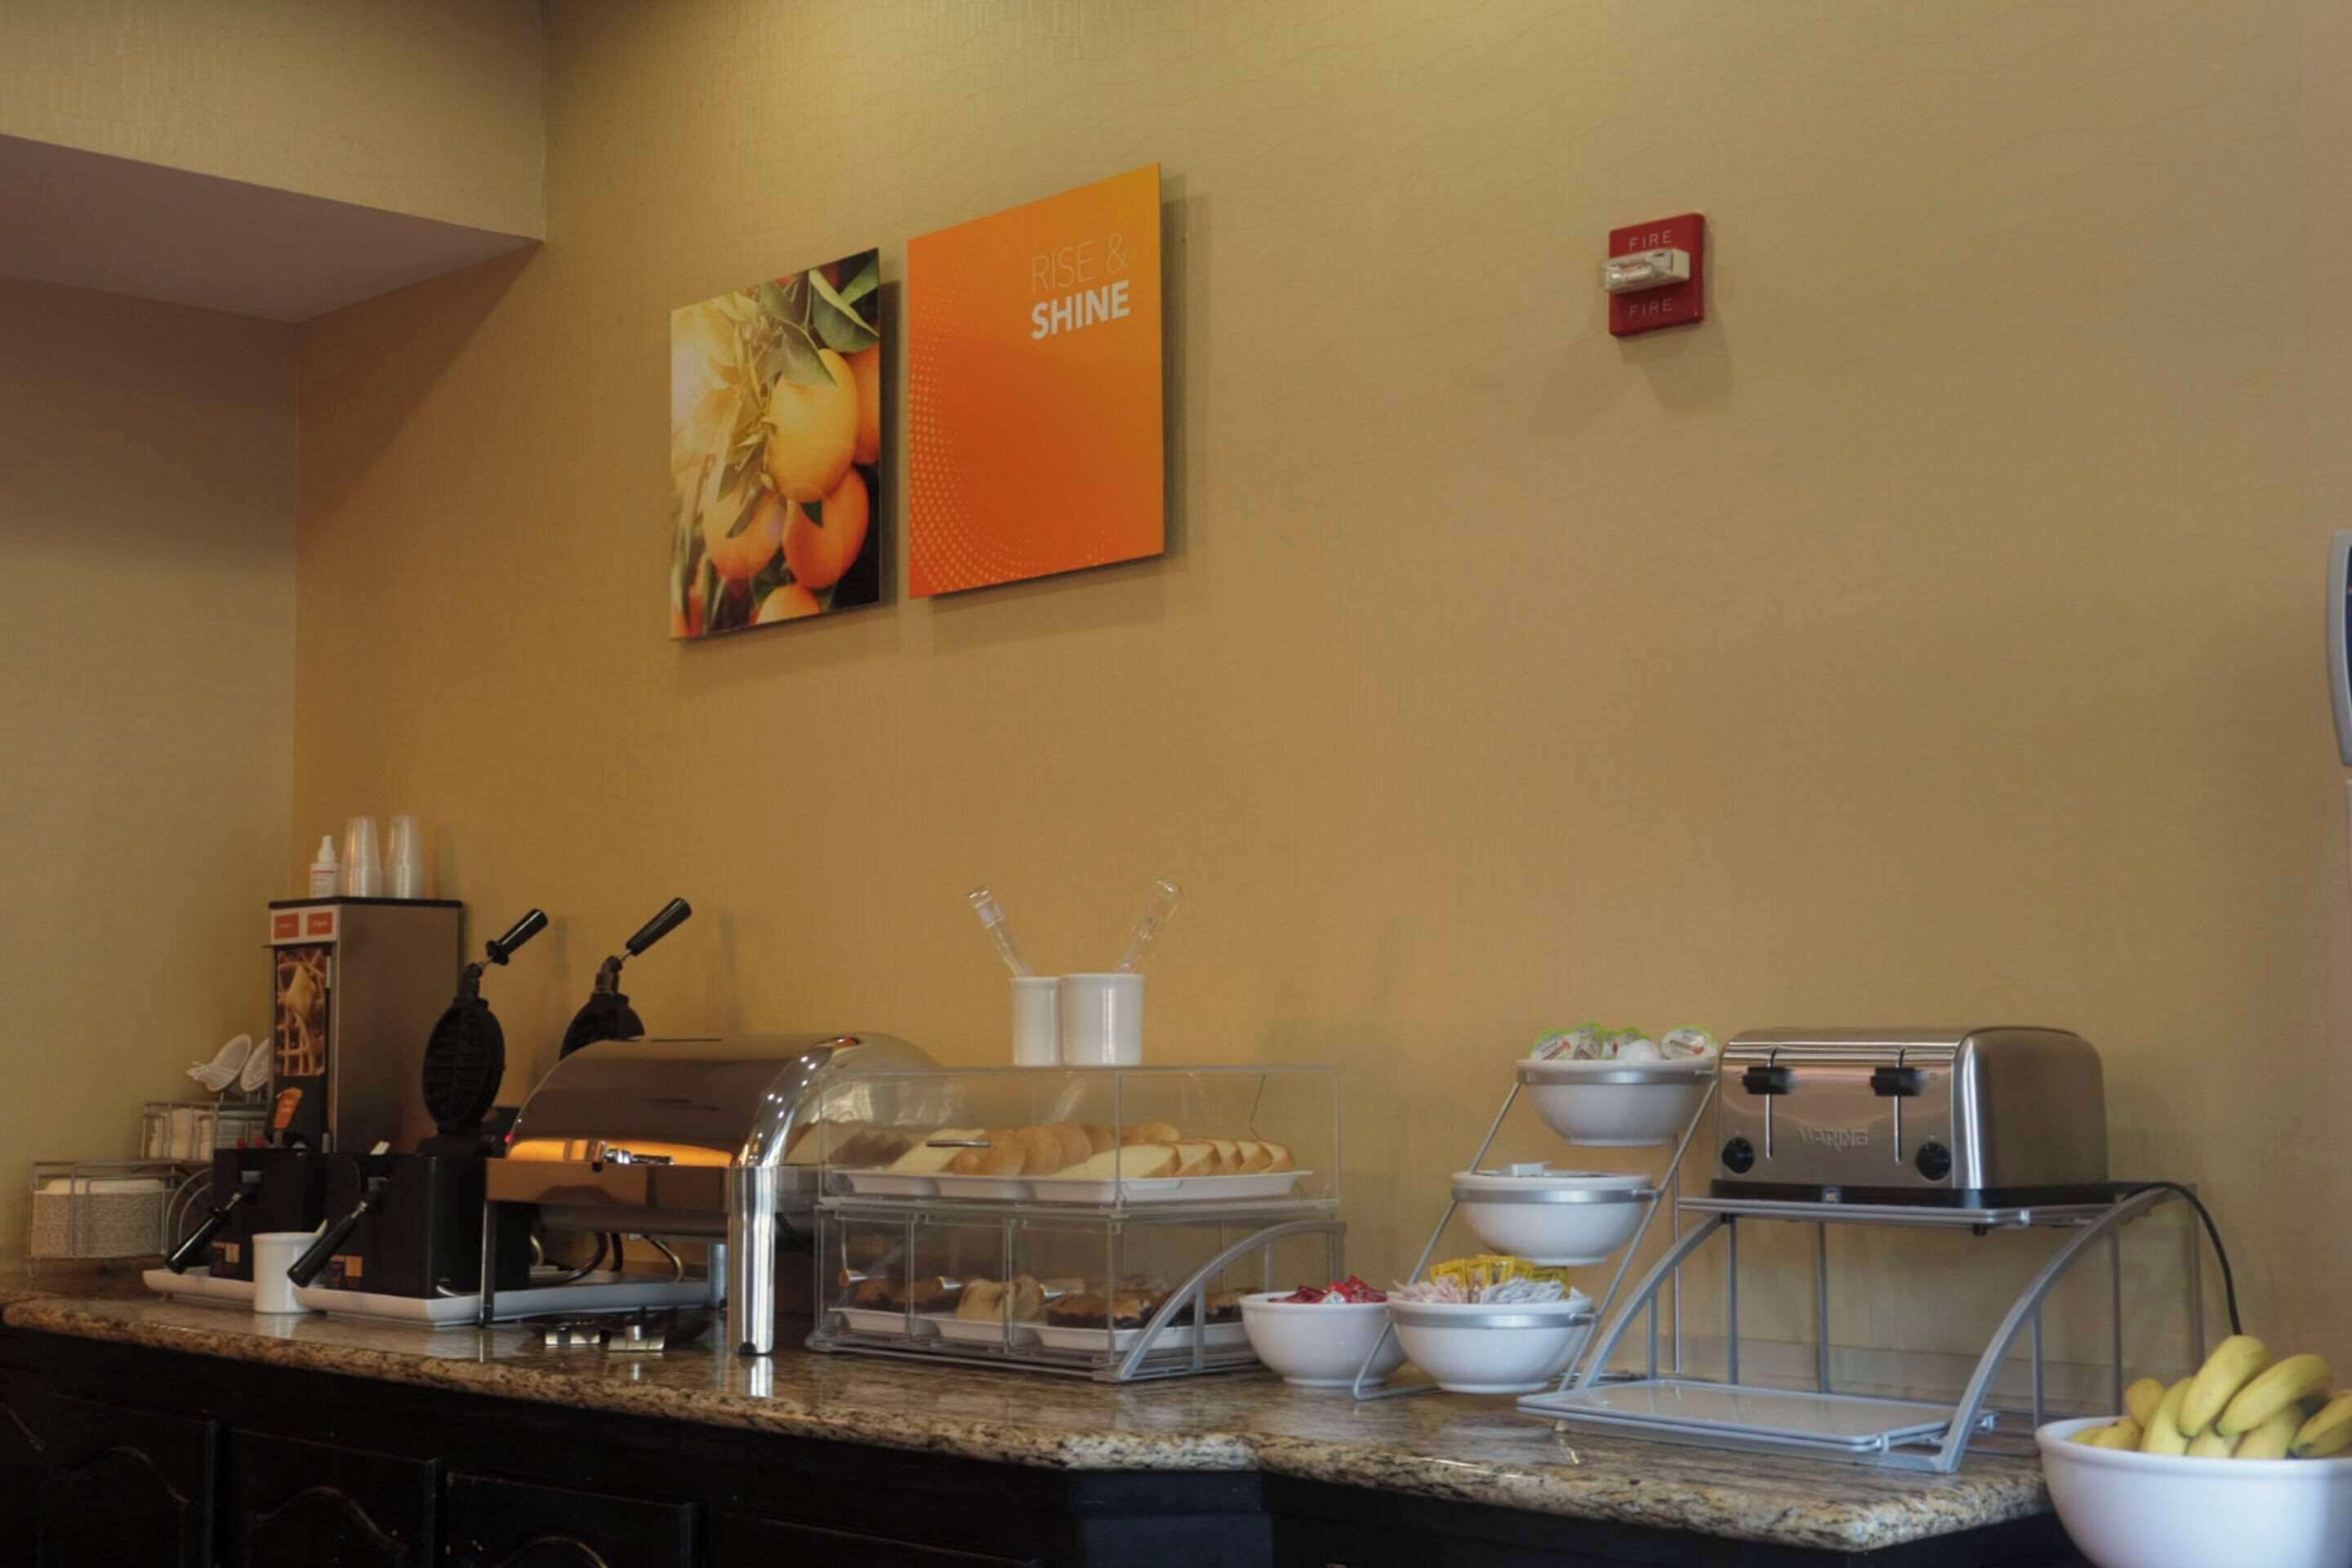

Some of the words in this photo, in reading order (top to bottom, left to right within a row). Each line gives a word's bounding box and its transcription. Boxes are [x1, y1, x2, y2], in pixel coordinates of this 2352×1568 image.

[1629, 230, 1673, 251] FIRE
[1031, 240, 1097, 295] RISE
[1107, 232, 1129, 275] &
[1031, 278, 1131, 340] SHINE
[1629, 298, 1673, 318] FIRE
